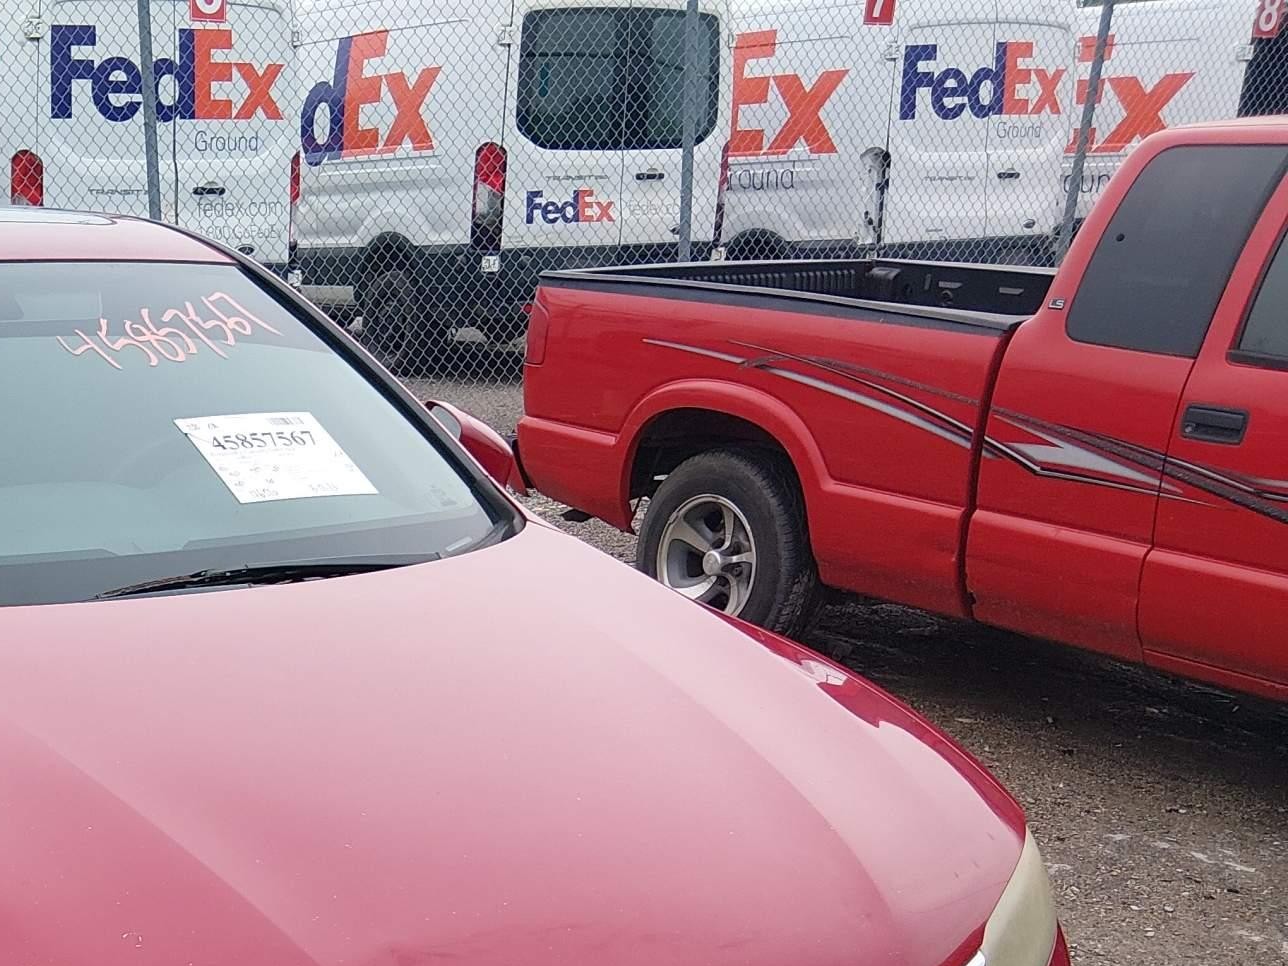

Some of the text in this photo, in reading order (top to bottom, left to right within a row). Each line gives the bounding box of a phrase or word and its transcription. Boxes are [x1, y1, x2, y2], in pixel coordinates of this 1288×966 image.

[50, 25, 284, 123] FedEx
[899, 41, 1067, 121] FedEx
[996, 120, 1042, 139] Ground
[194, 130, 259, 152] Ground
[197, 197, 283, 218] fedex.com
[526, 189, 616, 224] FedEx
[213, 430, 316, 451] 45857567
